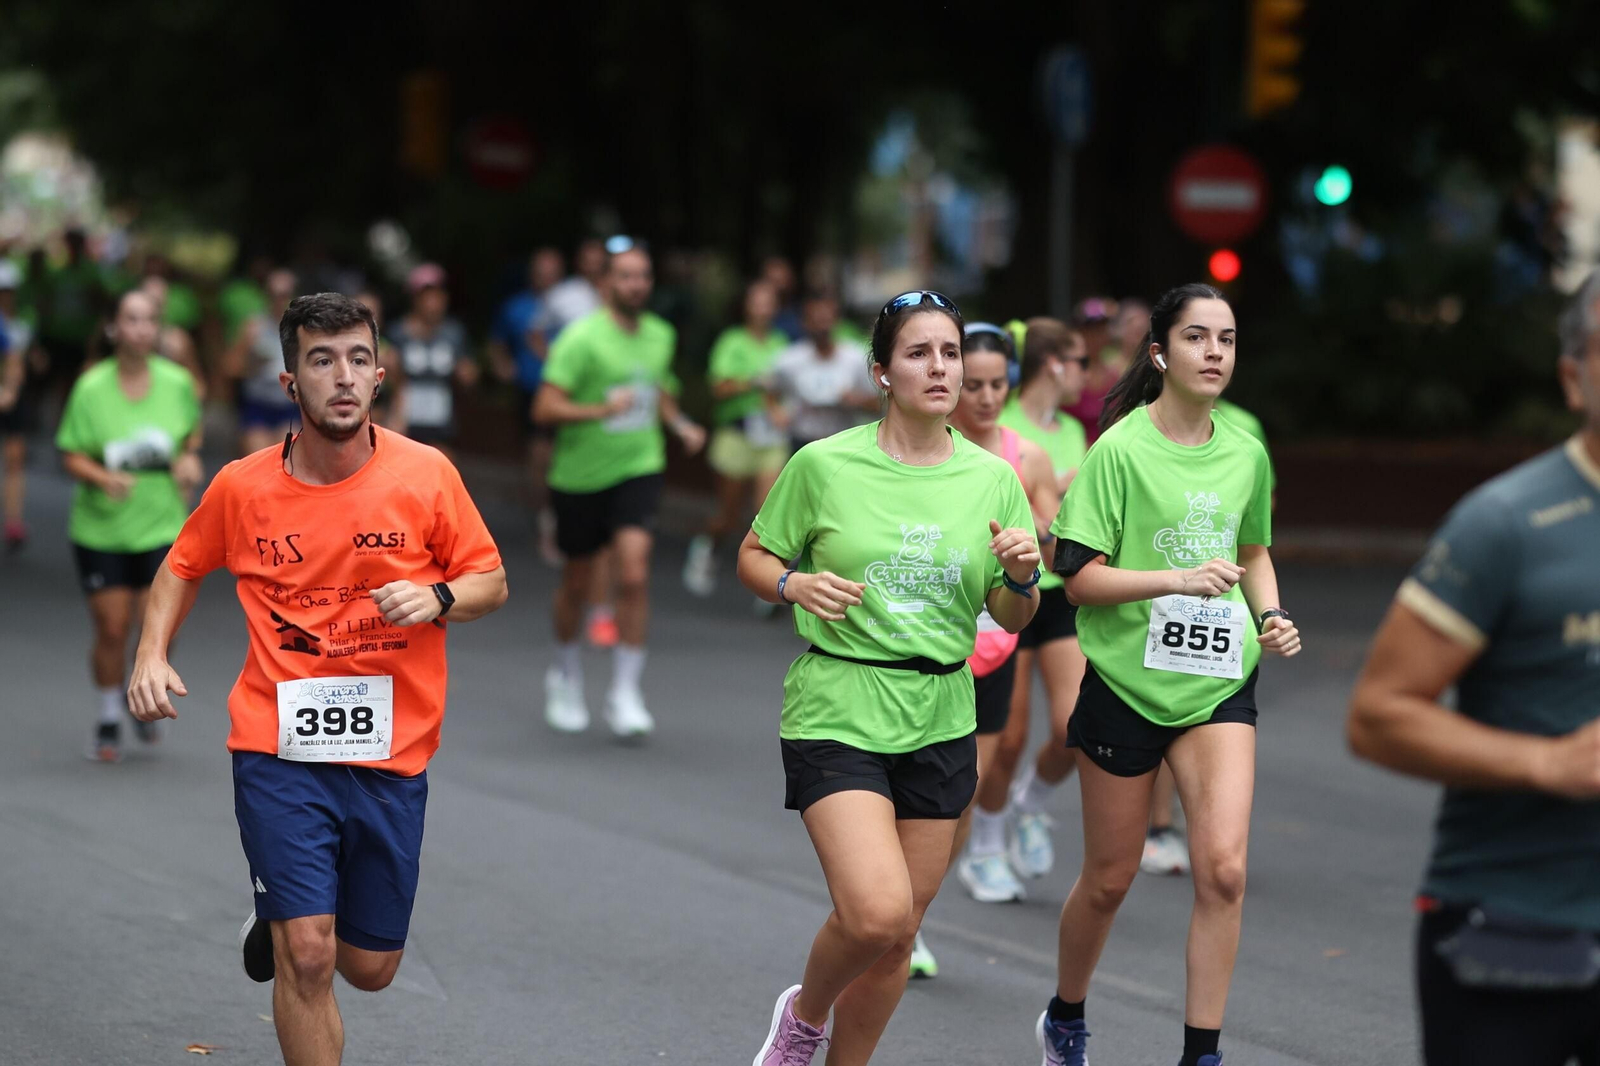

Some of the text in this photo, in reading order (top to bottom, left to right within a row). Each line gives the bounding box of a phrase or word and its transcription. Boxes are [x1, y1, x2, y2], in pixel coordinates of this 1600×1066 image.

[1156, 529, 1223, 547] Carrera
[866, 563, 945, 582] Carrera
[885, 581, 949, 596] Prensa
[327, 616, 394, 636] P. LEIV
[329, 631, 402, 647] Pilar y Francisco
[381, 639, 408, 651] REFORMAS
[1161, 621, 1231, 654] 855
[312, 683, 359, 697] Carrera
[295, 706, 374, 737] 398
